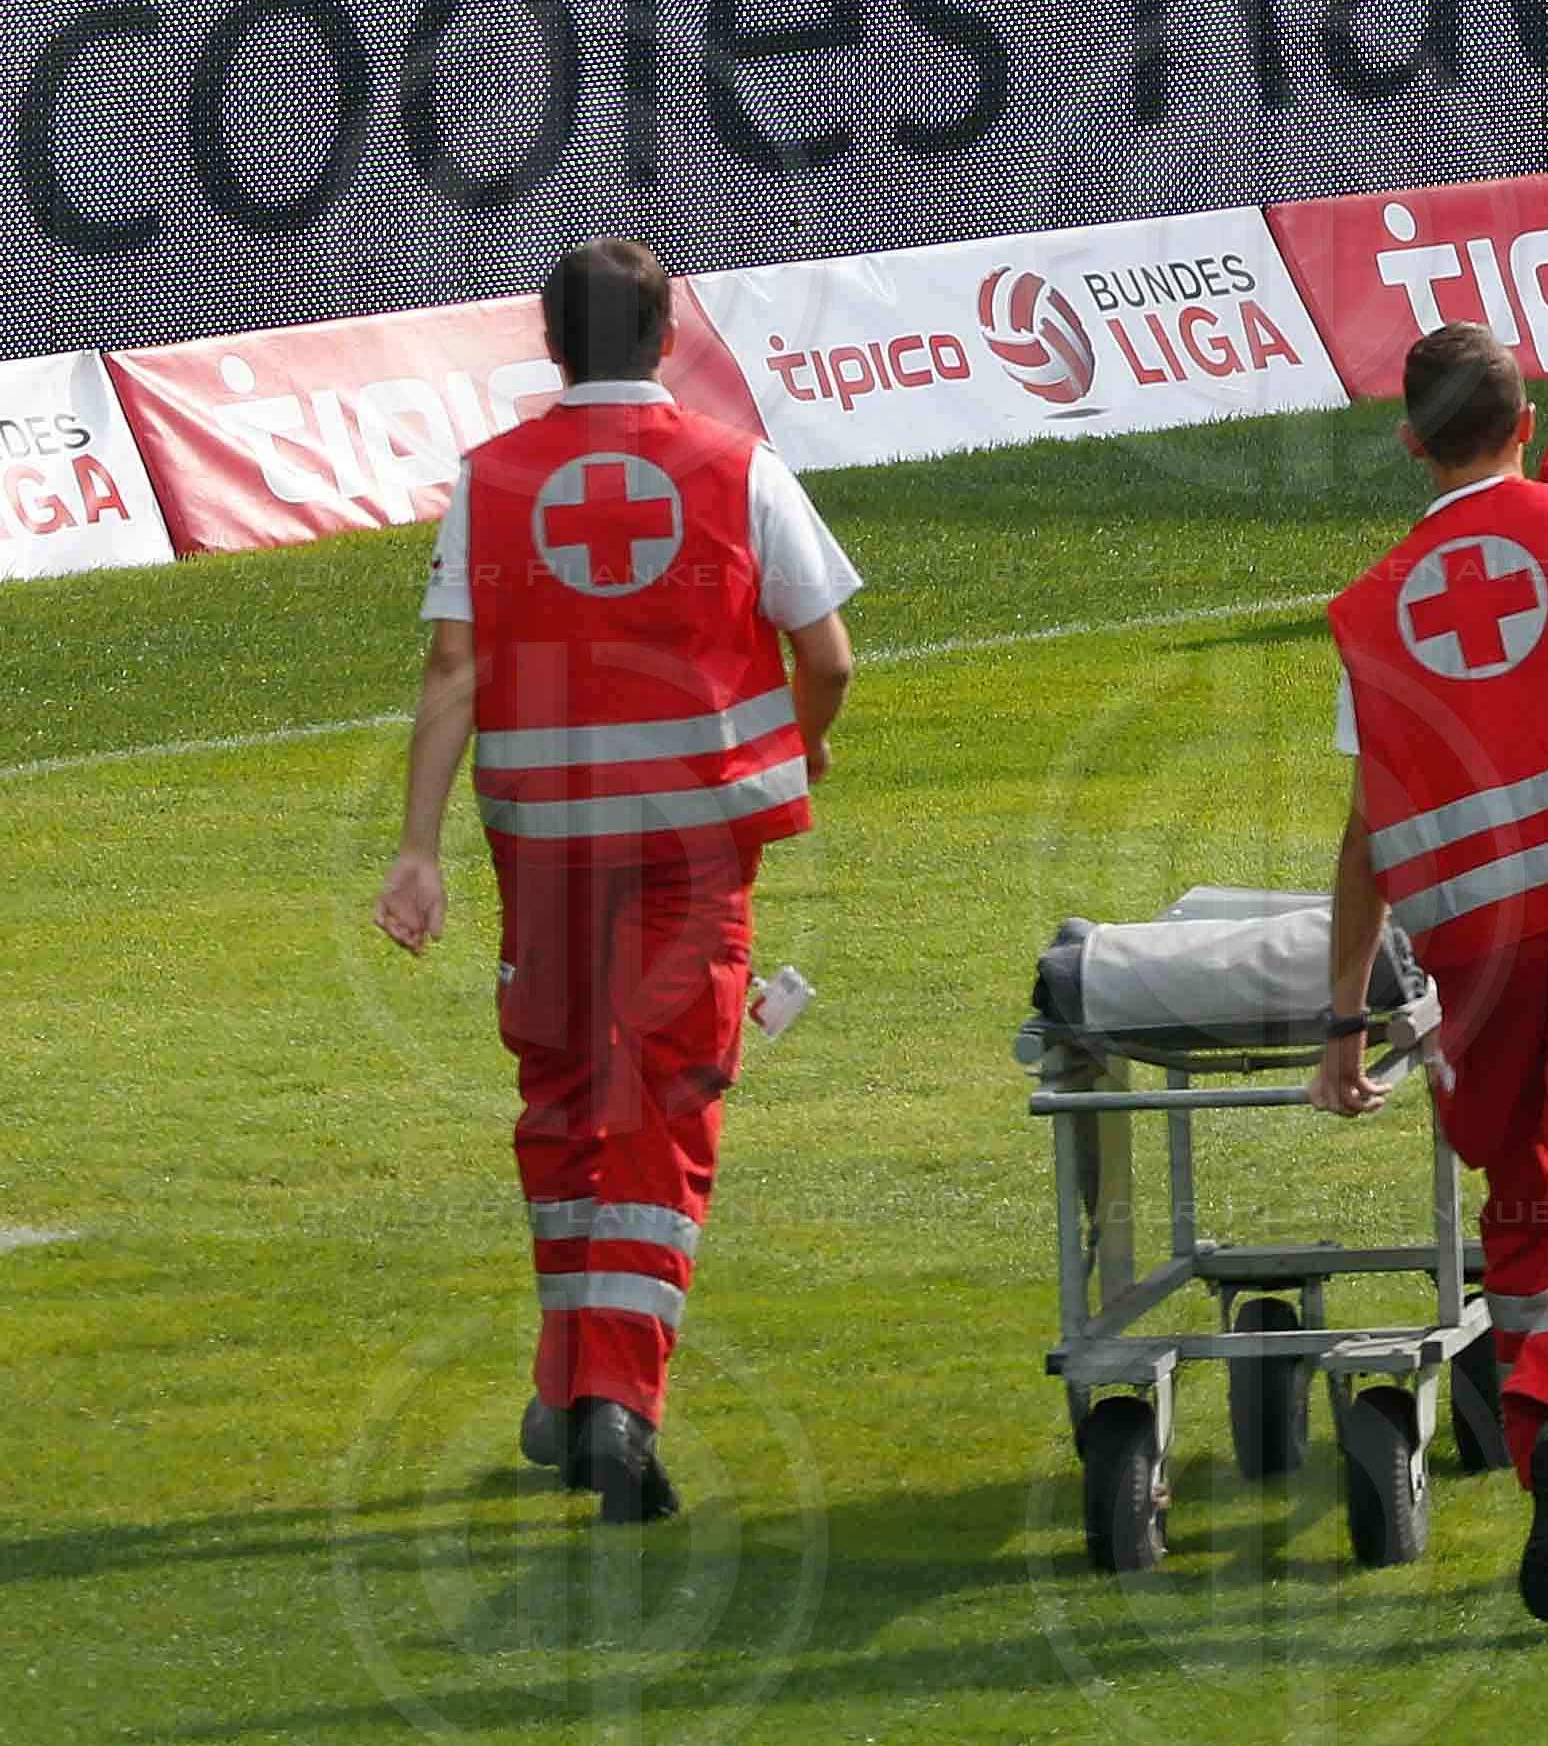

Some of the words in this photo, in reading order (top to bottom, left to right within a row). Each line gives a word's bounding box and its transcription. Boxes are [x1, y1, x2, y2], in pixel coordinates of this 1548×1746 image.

[1082, 253, 1258, 312] BUNDES
[766, 334, 973, 411] tipico
[1105, 300, 1302, 386] LIGA
